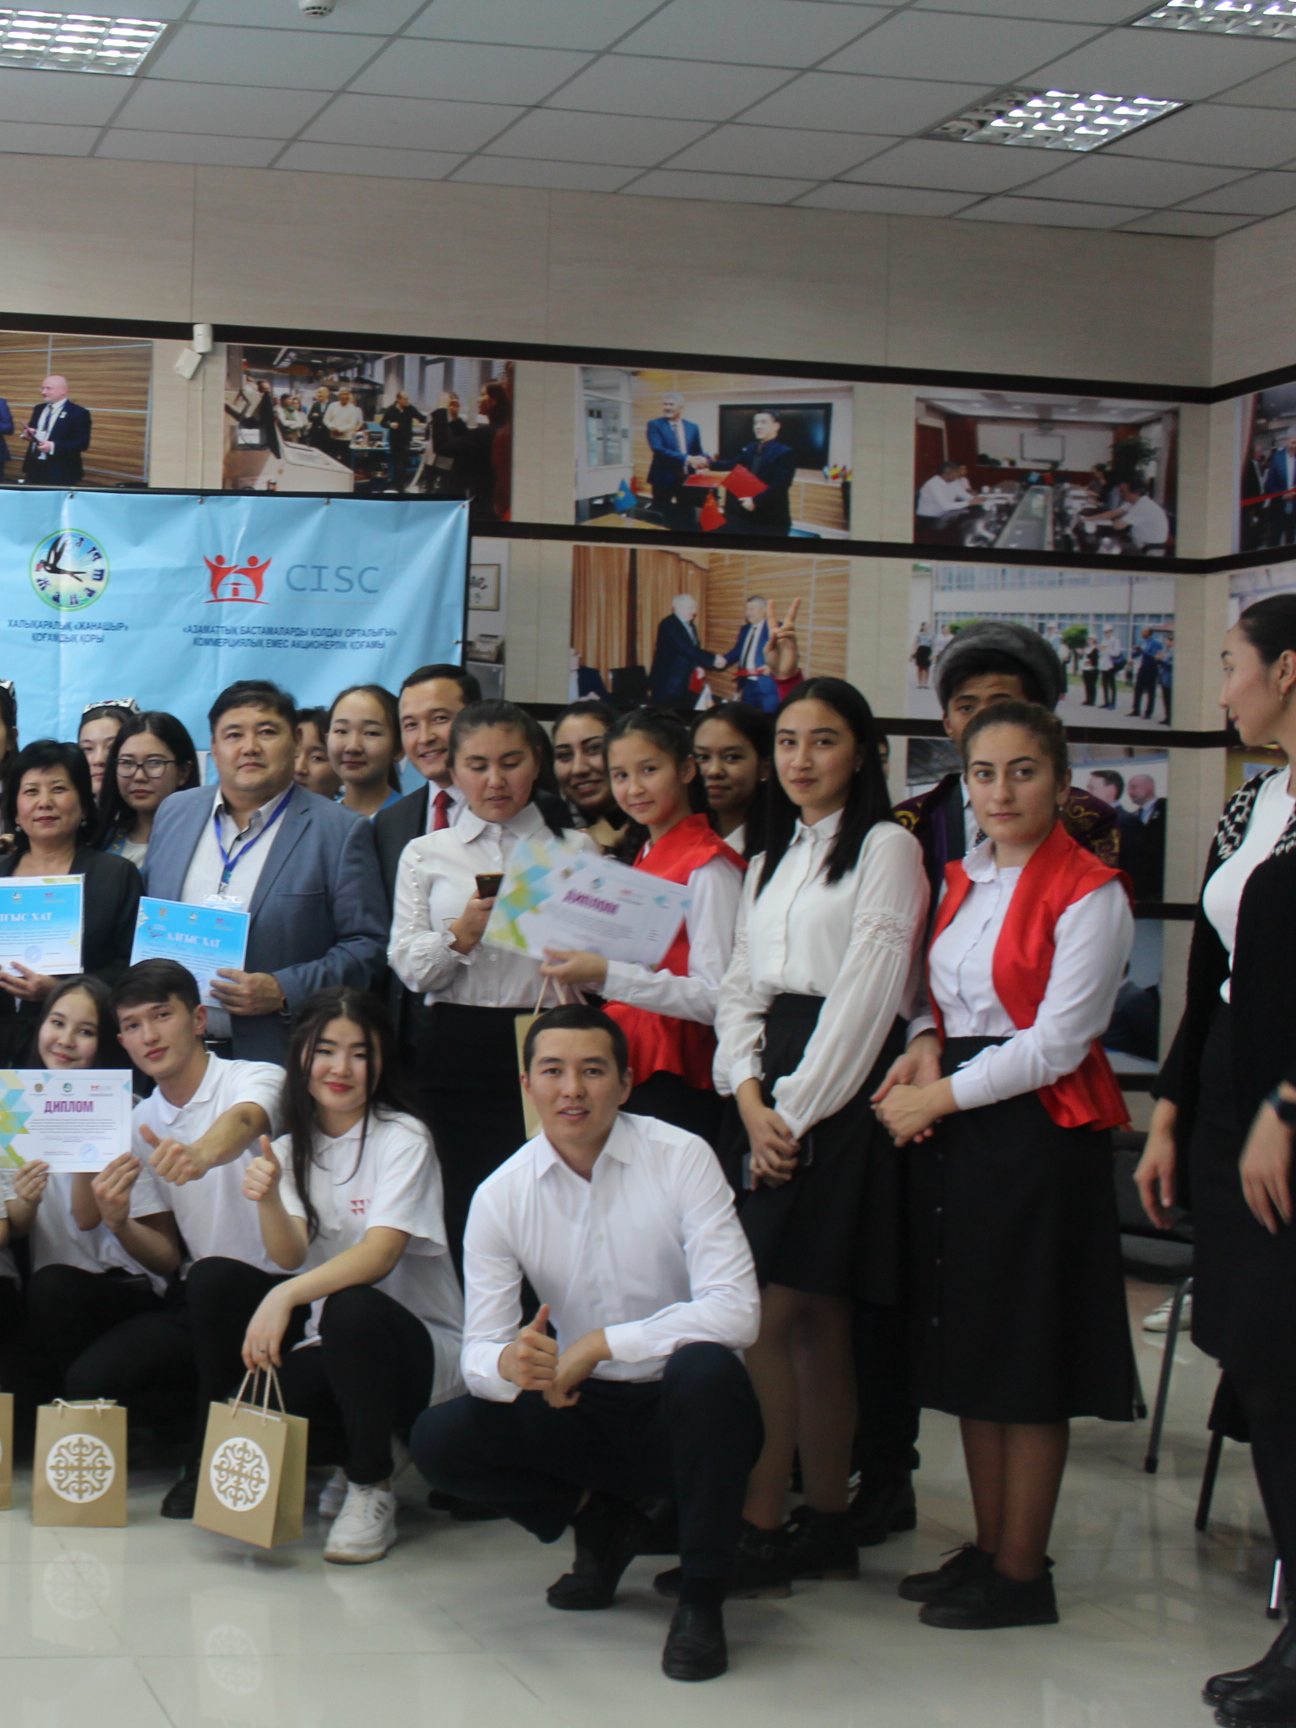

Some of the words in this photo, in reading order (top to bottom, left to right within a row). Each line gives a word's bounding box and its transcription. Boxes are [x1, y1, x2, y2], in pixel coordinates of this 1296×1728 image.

[285, 564, 380, 594] CISC
[266, 638, 289, 648] ЕМЕС
[44, 1100, 94, 1115] ДИПЛОМ
